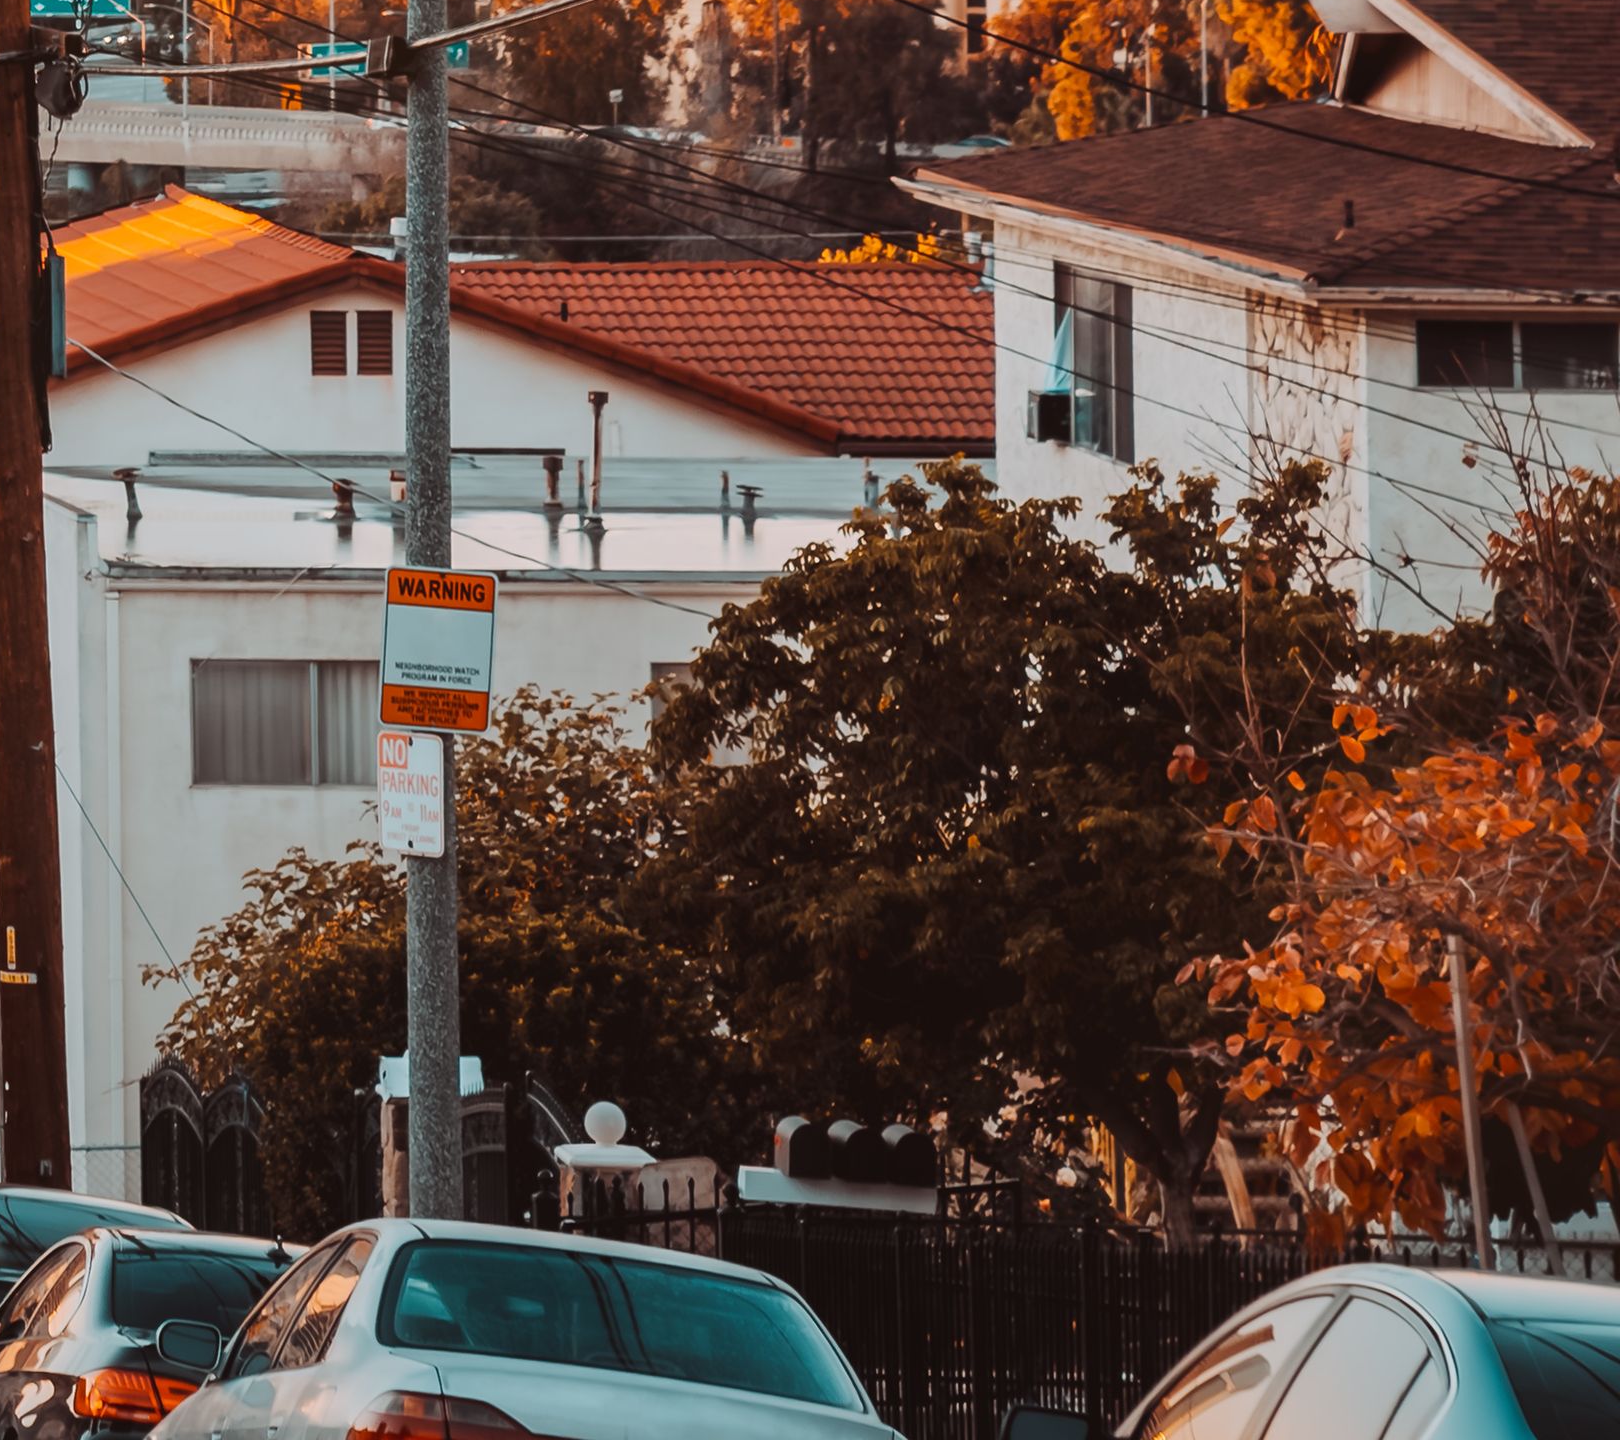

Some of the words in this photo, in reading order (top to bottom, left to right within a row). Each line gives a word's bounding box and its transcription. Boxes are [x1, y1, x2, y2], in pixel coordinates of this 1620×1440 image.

[398, 577, 485, 603] WARNING
[395, 662, 453, 674] NEIGHBORHOOD
[455, 667, 480, 675] WATCH
[402, 672, 437, 681] PROGRAM
[448, 676, 471, 685] FORCE
[383, 737, 406, 766] NO
[382, 771, 439, 797] PARKING
